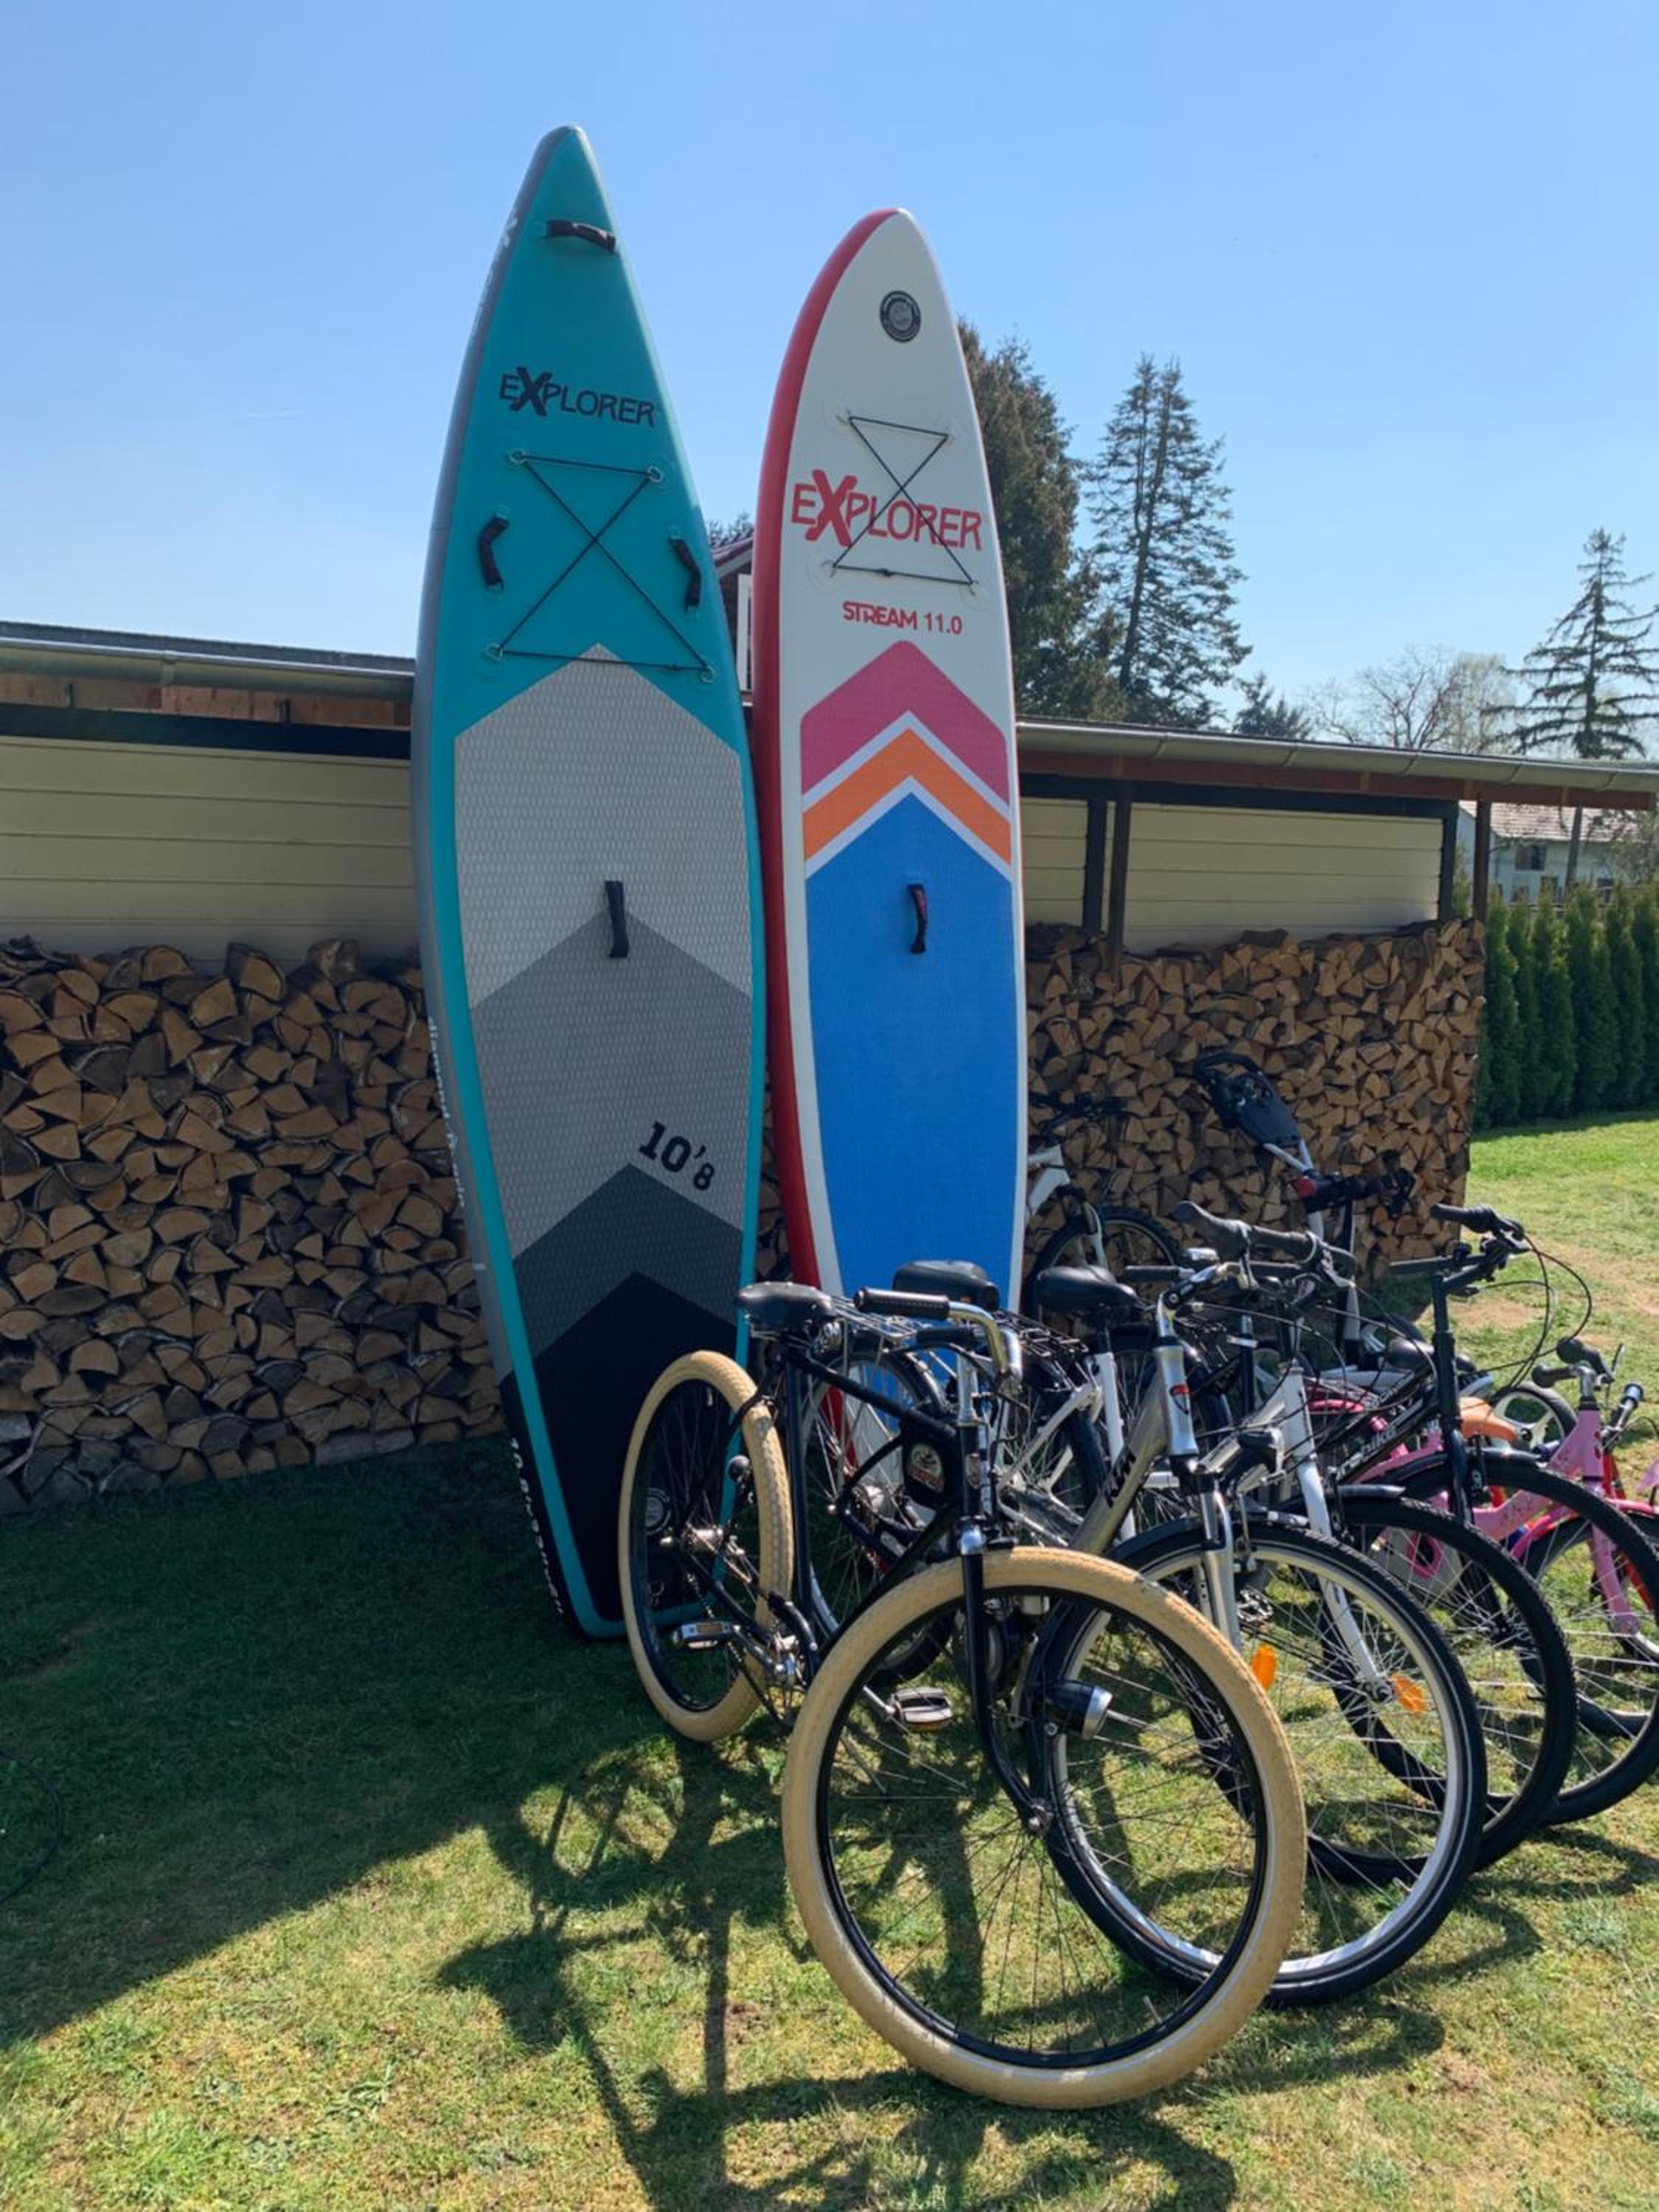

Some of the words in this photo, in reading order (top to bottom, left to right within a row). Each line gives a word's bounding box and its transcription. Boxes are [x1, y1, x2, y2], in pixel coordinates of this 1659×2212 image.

[499, 366, 655, 428] EXPLORER
[791, 469, 982, 551] EXPLORER
[842, 600, 918, 630] STREAM
[923, 612, 963, 635] 11.0
